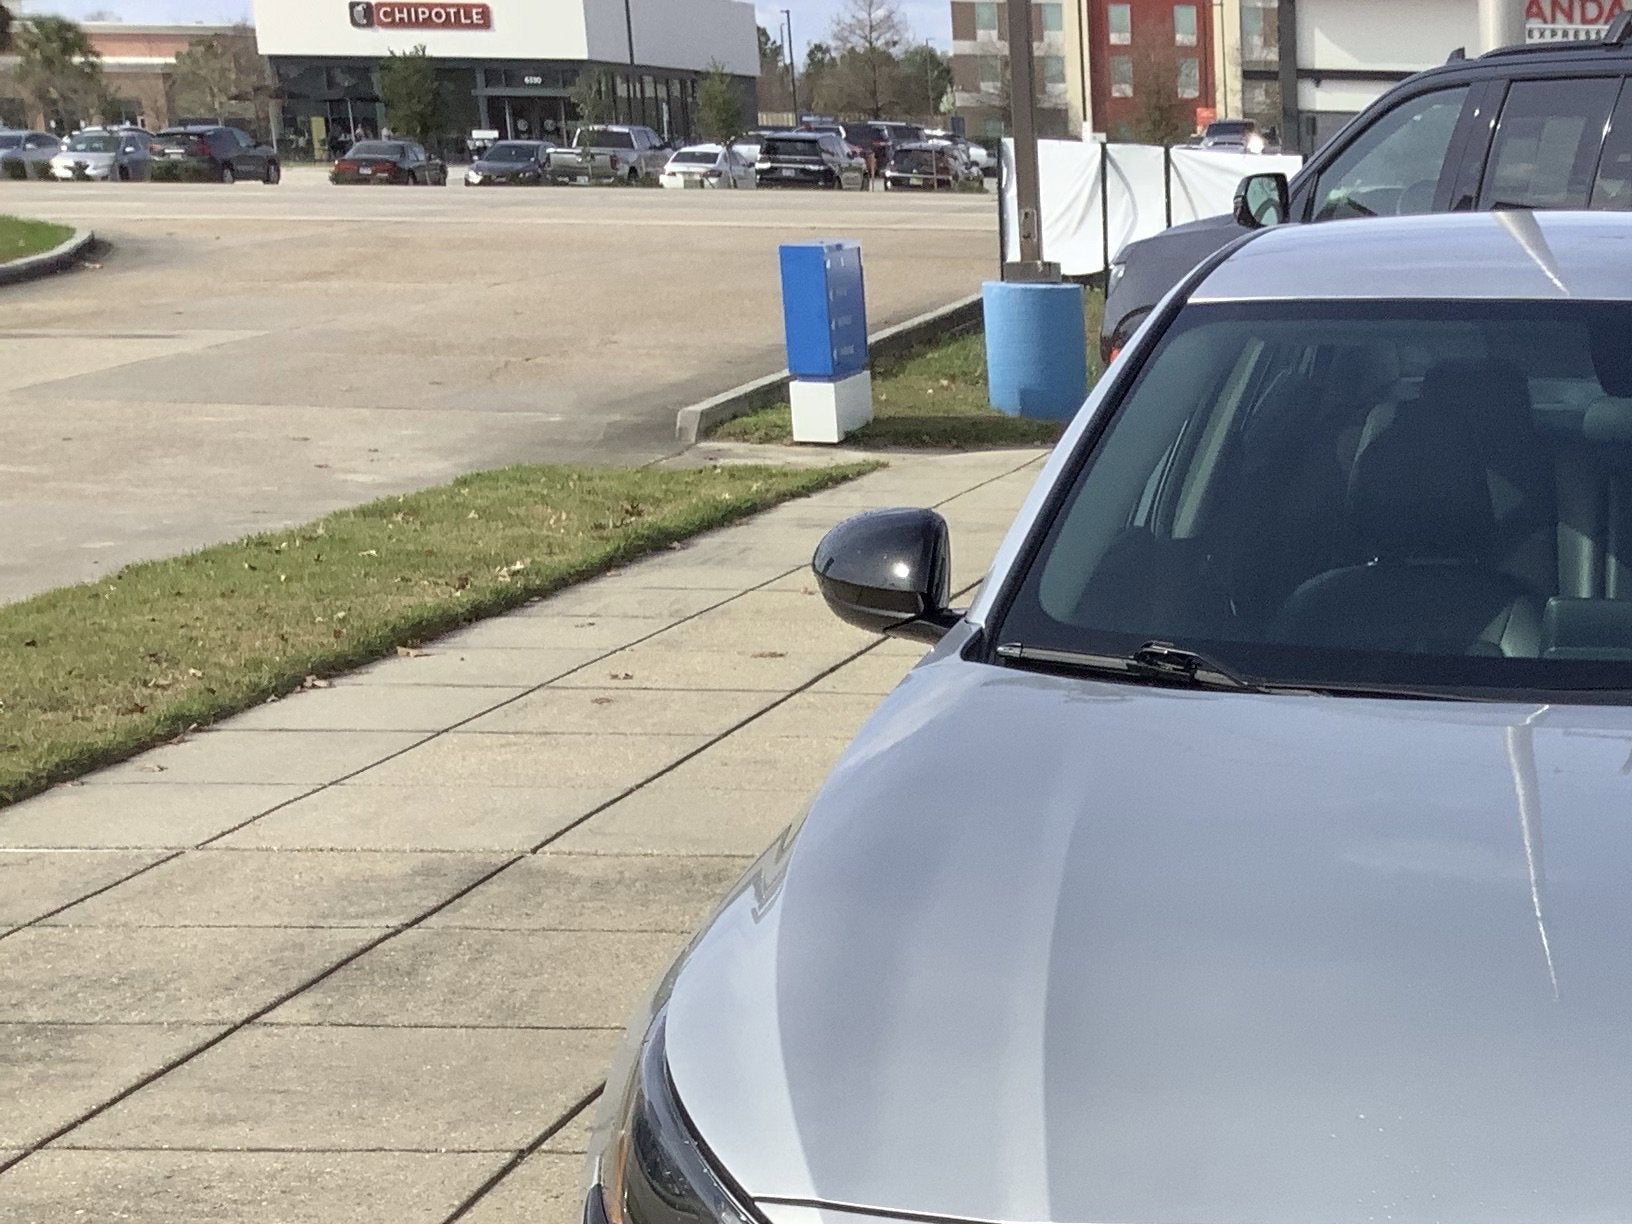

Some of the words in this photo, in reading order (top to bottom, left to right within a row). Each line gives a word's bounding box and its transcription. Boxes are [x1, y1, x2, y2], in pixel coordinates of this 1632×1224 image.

[379, 6, 485, 24] CHIPOTLE
[1525, 0, 1625, 24] ANDA
[1527, 28, 1602, 39] EXPRESS
